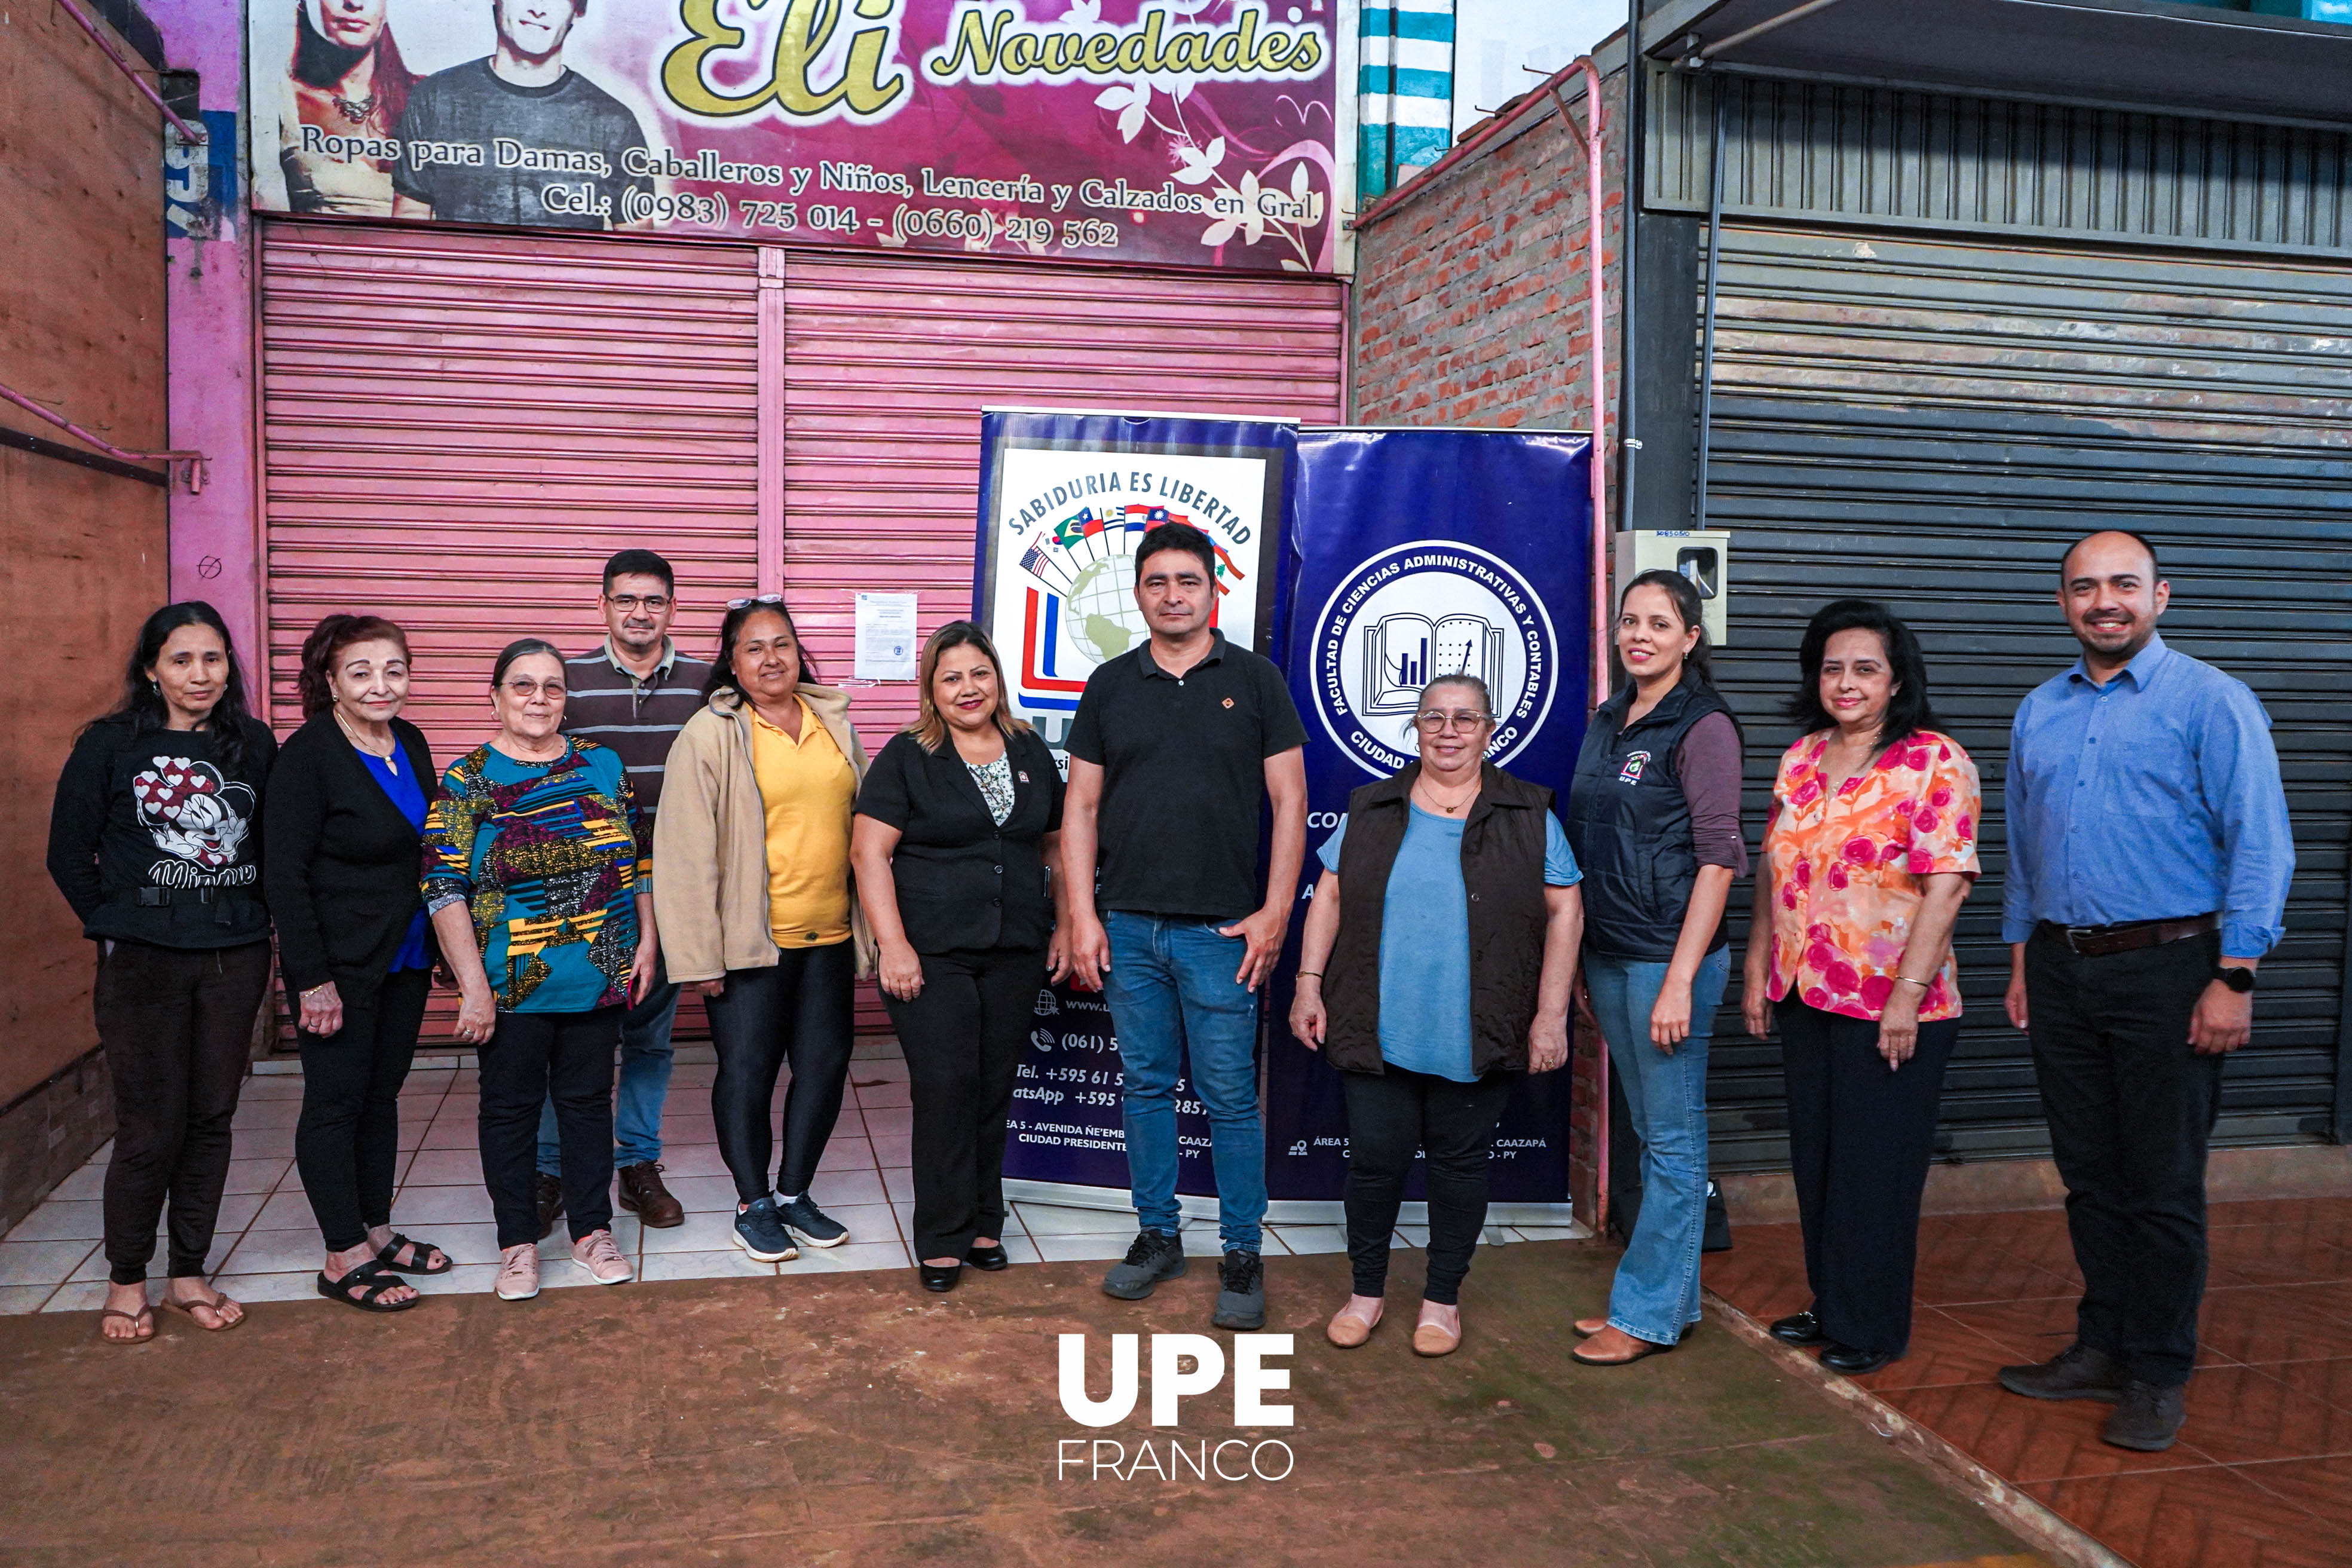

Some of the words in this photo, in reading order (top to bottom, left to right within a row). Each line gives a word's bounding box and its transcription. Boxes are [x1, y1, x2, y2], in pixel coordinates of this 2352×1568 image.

[661, 0, 904, 117] Eli
[930, 8, 1322, 75] Novedades
[302, 127, 399, 159] Ropas
[411, 141, 483, 170] para
[497, 139, 610, 176] Damas,
[622, 149, 780, 186] Caballeros
[792, 168, 811, 197] y
[821, 162, 913, 198] Niños,
[924, 169, 1042, 204] Lencería
[1052, 183, 1071, 211] y
[1082, 180, 1202, 213] Calzados
[1214, 197, 1245, 216] en
[1257, 193, 1319, 221] Gral.
[544, 186, 611, 216] Cel.:
[624, 187, 728, 229] (0983)
[740, 200, 797, 231] 725
[809, 206, 856, 235] 014
[894, 209, 995, 247] (0660)
[1007, 219, 1052, 246] 219
[1062, 220, 1117, 248] 562
[1009, 472, 1121, 535] SABIDURIA
[1130, 471, 1153, 493] ES
[1160, 476, 1251, 545] LIBERTAD
[1342, 562, 1400, 615] CIENCIAS
[1404, 555, 1527, 615] ADMINISTRATIVAS
[1334, 615, 1346, 636] DE
[1523, 615, 1535, 626] Y
[1326, 638, 1348, 715] FACULTAD
[1516, 630, 1542, 719] CONTABLES
[1350, 730, 1405, 770] CIUDAD
[1619, 776, 1637, 786] UPE
[1062, 1033, 1104, 1054] (061)
[1016, 1064, 1039, 1079] Tel.
[1046, 1067, 1086, 1083] +595
[1091, 1070, 1108, 1085] 61
[1013, 1086, 1064, 1105] atsApp
[1075, 1091, 1116, 1107] +595
[1018, 1133, 1061, 1146] CIUDAD
[1186, 1149, 1200, 1159] PY
[1020, 1121, 1026, 1129] 5
[1034, 1122, 1083, 1135] AVENIDA
[1085, 1125, 1125, 1139] ÑE'EMB
[1178, 1136, 1212, 1147] CAAZ
[1313, 1136, 1341, 1146] ÁREA
[1343, 1138, 1349, 1146] 5
[1496, 1138, 1547, 1148] CAAZAPÁ
[1503, 1151, 1517, 1159] PY
